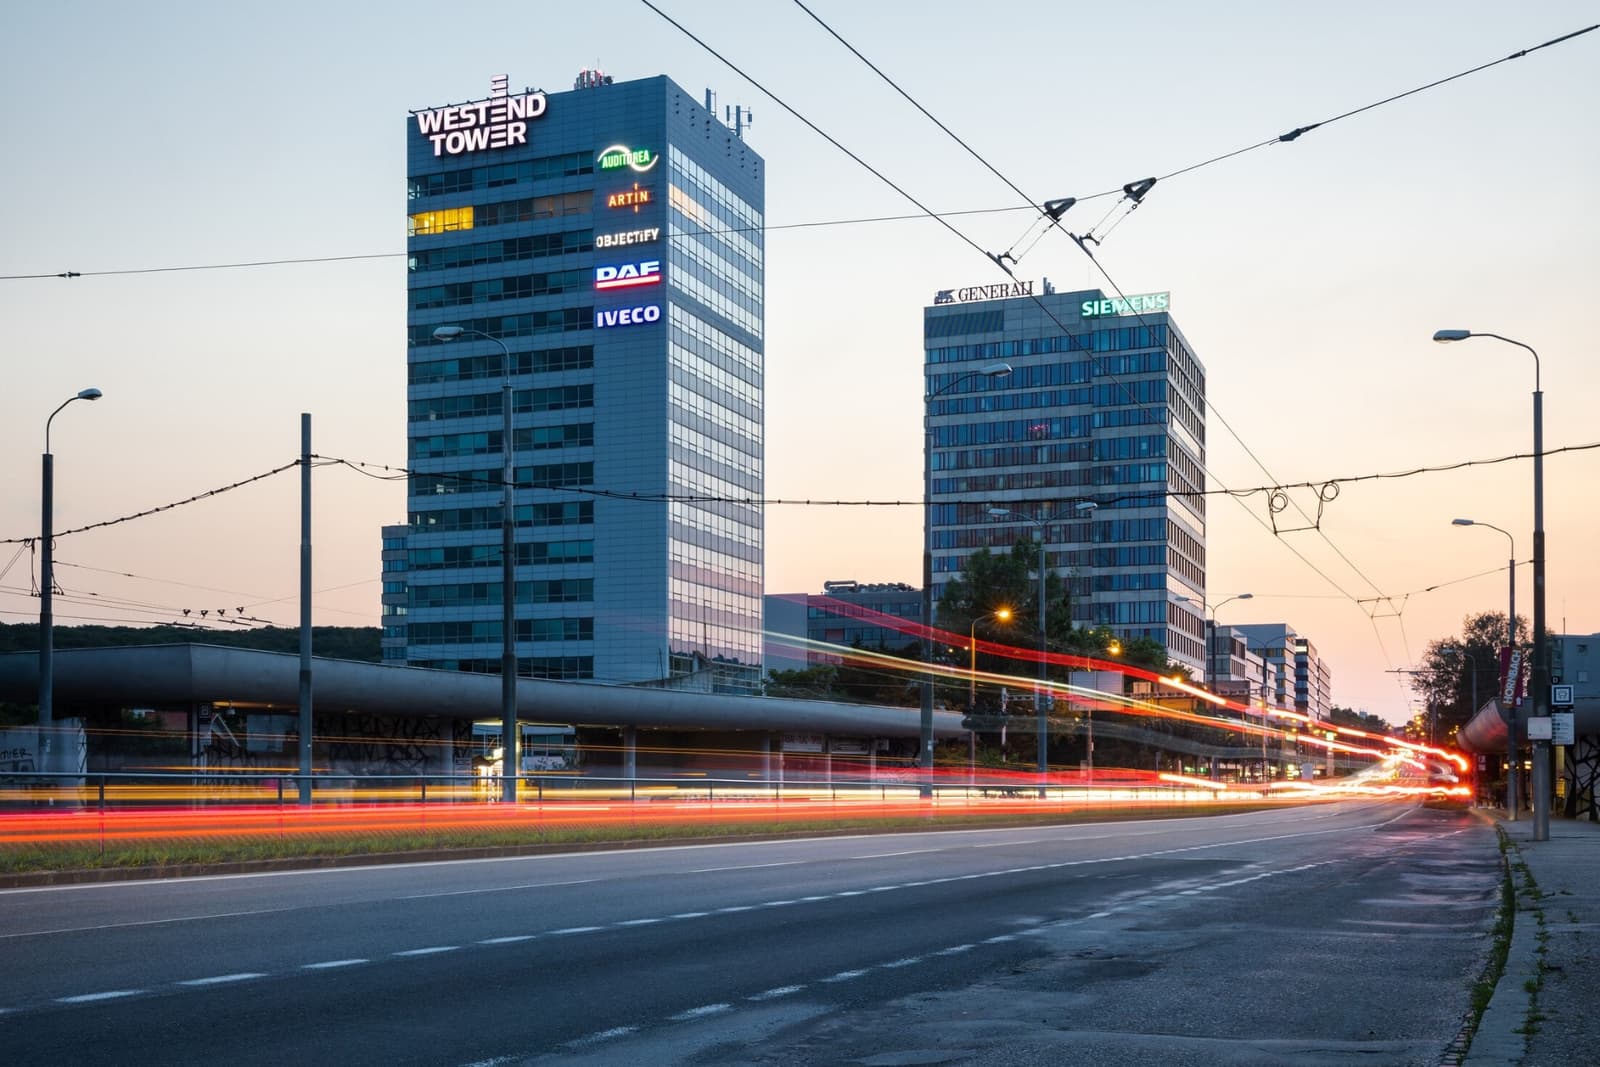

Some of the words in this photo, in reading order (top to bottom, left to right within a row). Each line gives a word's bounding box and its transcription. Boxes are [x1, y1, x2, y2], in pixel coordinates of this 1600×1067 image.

[417, 90, 546, 134] WESTEND
[430, 122, 526, 156] TOWER
[607, 185, 649, 211] ARTIN
[596, 261, 660, 281] DAF
[958, 281, 1034, 302] GENERALI
[597, 305, 660, 327] IVECO
[1081, 294, 1167, 317] SIEMENS
[1503, 649, 1521, 704] HORNBACH
